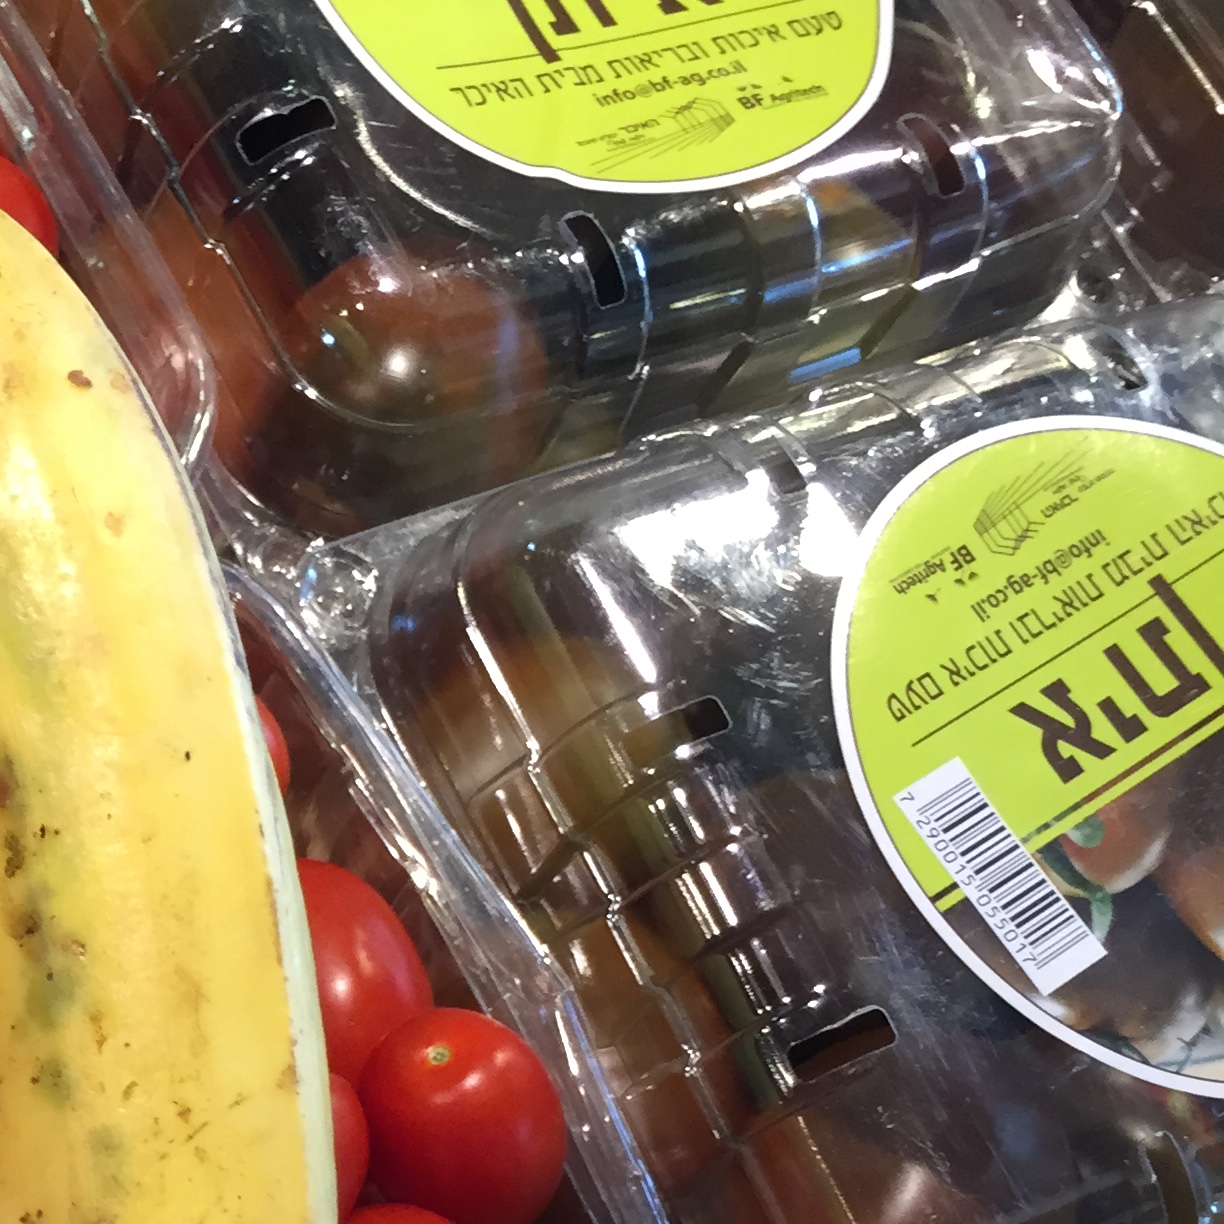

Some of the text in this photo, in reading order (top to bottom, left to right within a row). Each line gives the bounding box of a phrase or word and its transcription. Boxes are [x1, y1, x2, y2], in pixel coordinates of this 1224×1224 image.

[711, 23, 788, 55] איכות
[786, 10, 843, 38] טעם
[606, 41, 711, 79] ובריאות
[449, 77, 534, 108] האיכר
[536, 64, 605, 94] מבית
[592, 59, 748, 107] info@bf-ag.co.il
[737, 92, 765, 110] BF
[950, 544, 977, 572] BF
[892, 557, 947, 595] Agritech
[970, 529, 1111, 623] info@bf-ag.co.il
[887, 491, 1224, 723] טעם איכות ובריאות מבית האיכ
[899, 792, 1038, 966] 7 290015 055017
